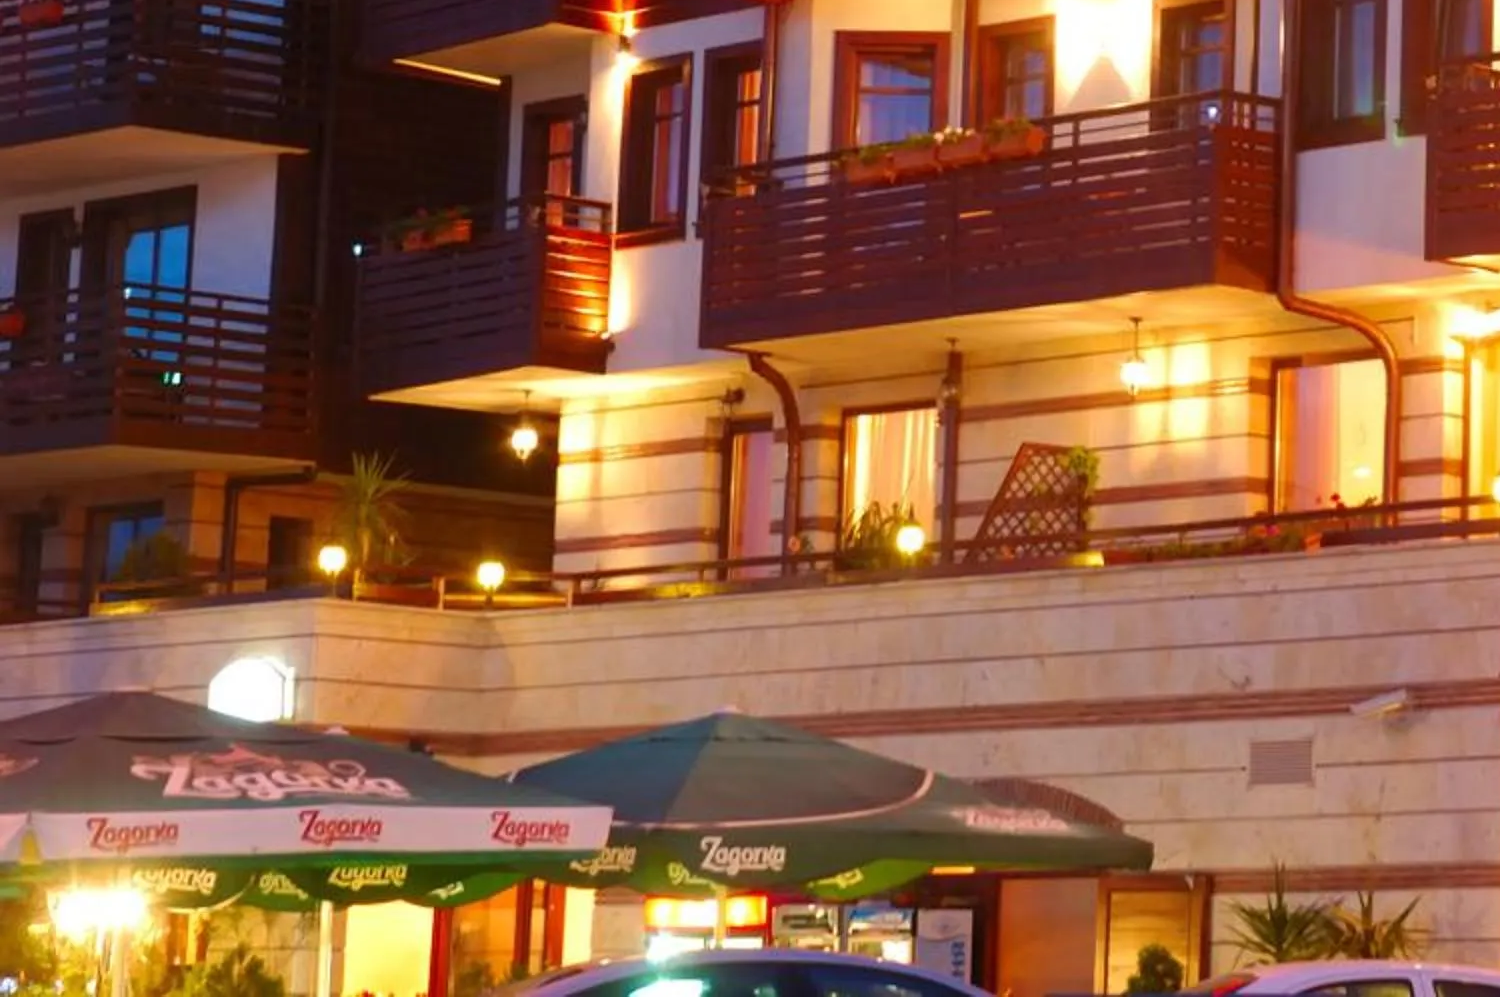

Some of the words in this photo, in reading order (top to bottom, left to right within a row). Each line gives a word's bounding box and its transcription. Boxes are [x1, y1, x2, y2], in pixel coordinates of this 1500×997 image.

[86, 817, 179, 853] Zagorka
[299, 810, 382, 846] Zagorka
[490, 811, 570, 847] Zagorka
[700, 835, 787, 876] Zagorka
